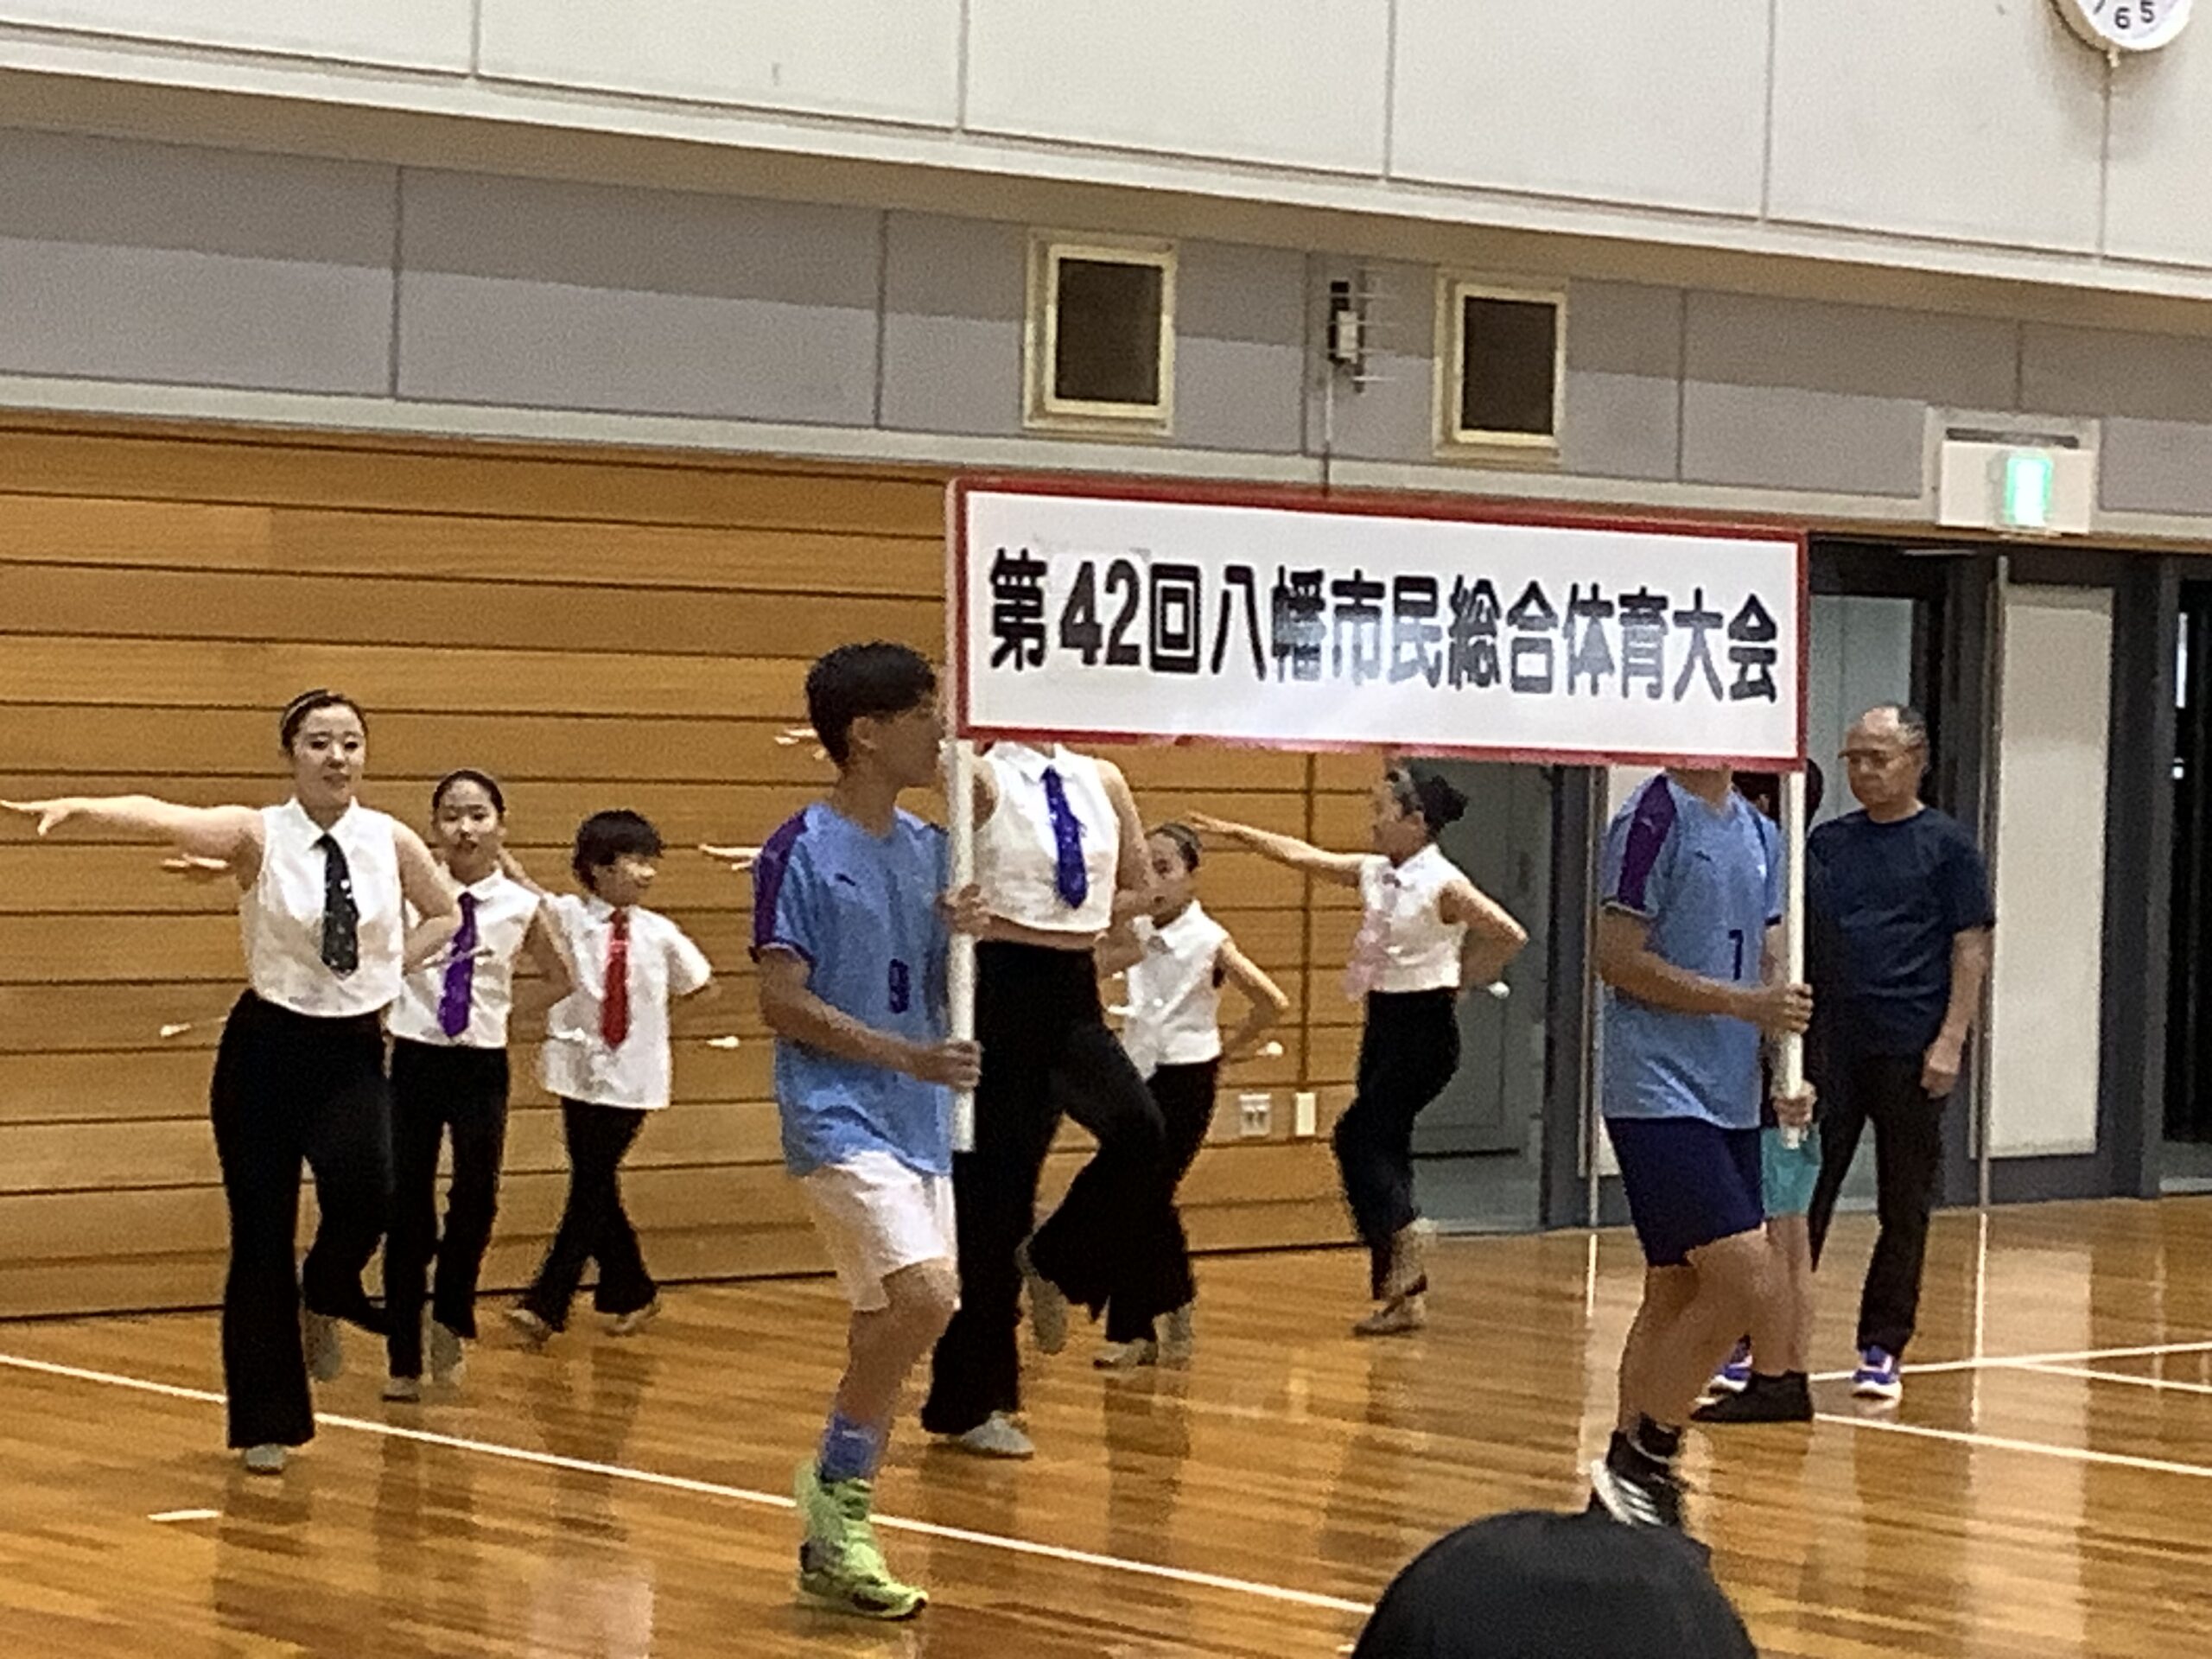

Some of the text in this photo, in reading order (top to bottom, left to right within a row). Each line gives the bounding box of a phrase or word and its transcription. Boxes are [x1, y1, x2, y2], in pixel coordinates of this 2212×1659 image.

[2114, 6, 2131, 29] 6
[2140, 1, 2154, 23] 5
[990, 548, 1777, 704] 第42回八幡市民総合体育大会
